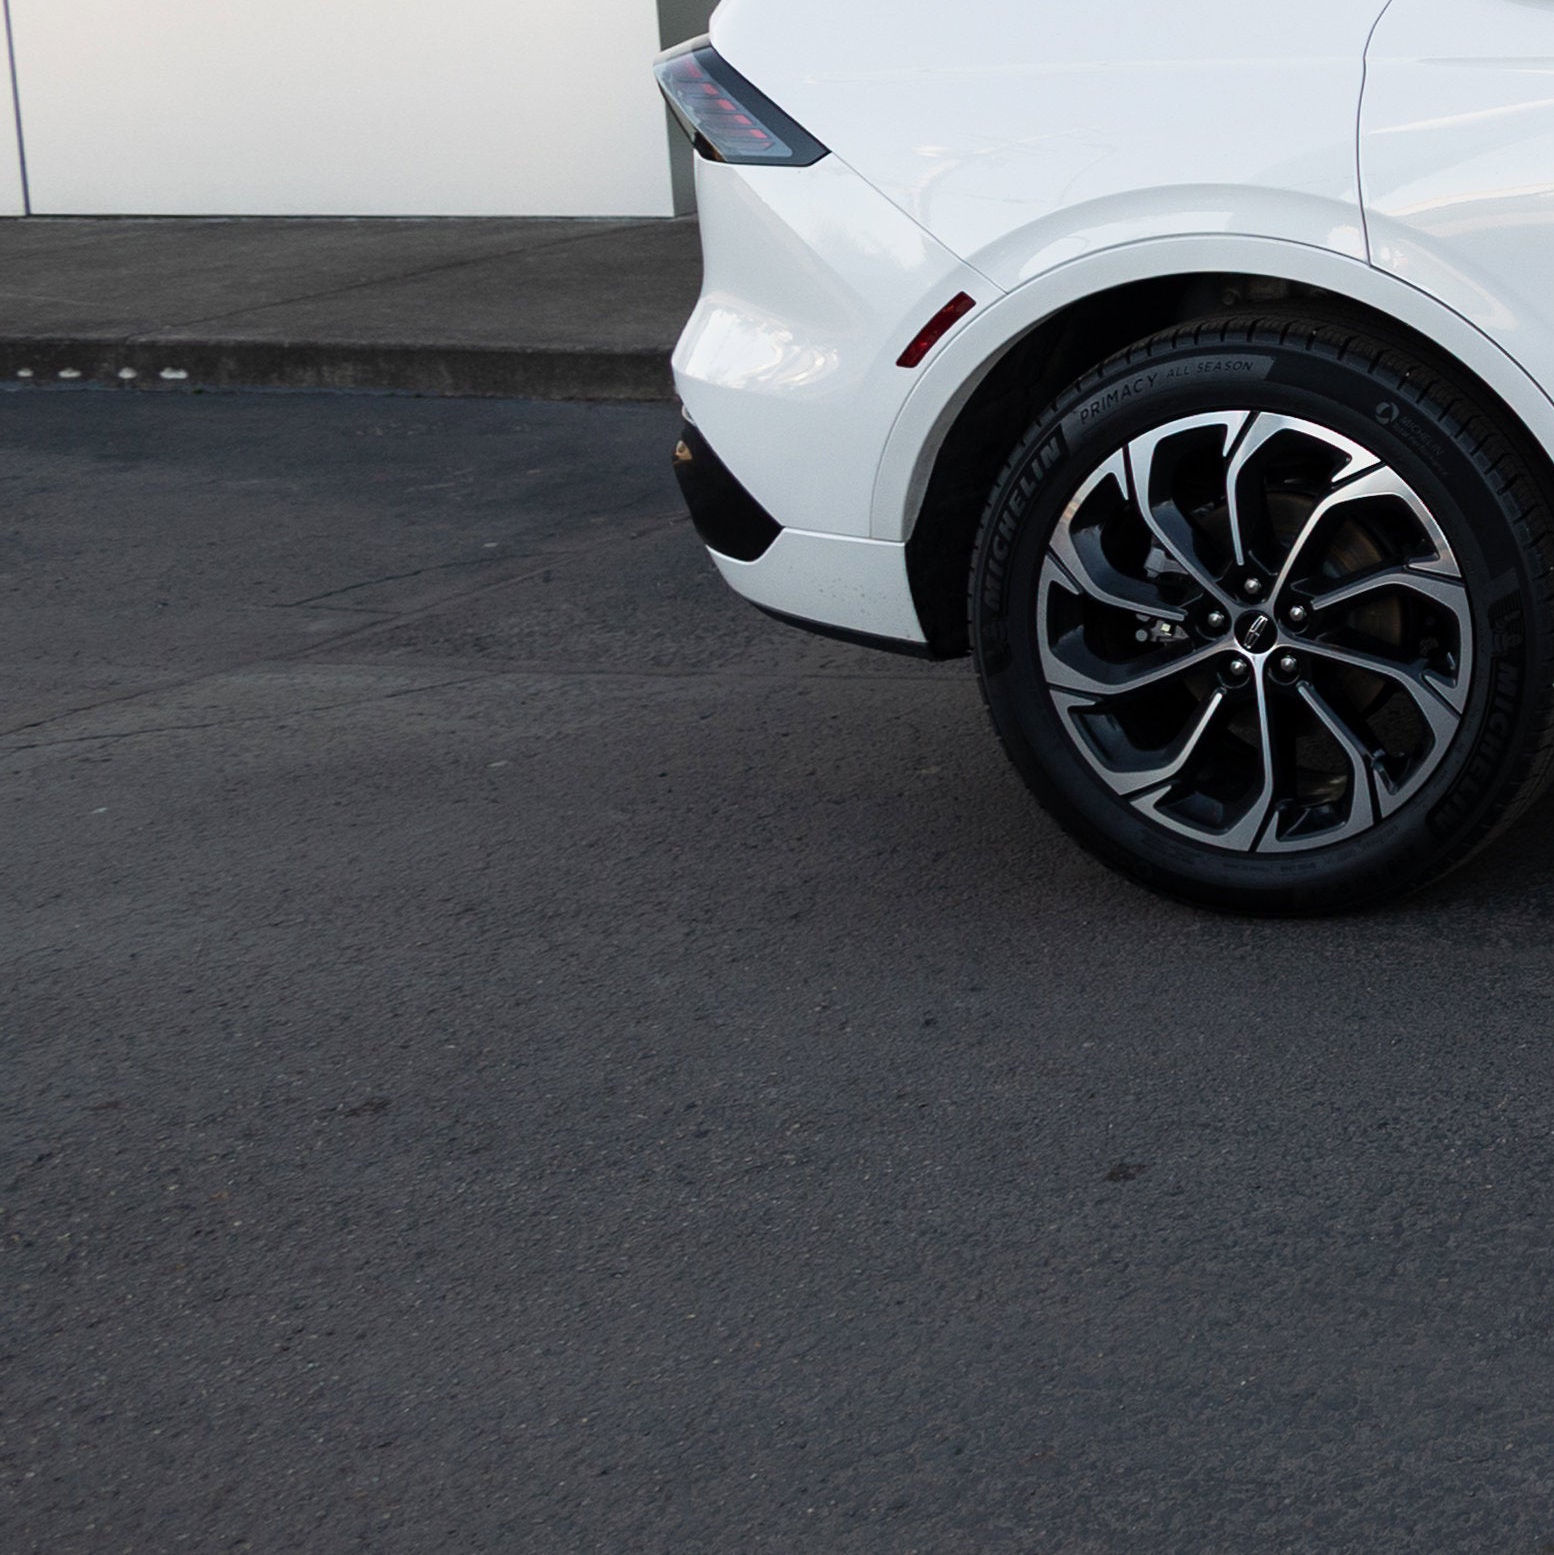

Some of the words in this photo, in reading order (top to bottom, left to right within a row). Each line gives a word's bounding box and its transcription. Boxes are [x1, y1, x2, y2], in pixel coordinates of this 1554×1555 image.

[1079, 372, 1159, 425] PRIMACY
[1166, 365, 1190, 379] ALL
[1195, 360, 1254, 374] SEASON
[984, 437, 1062, 612] MICHELIN
[1432, 662, 1521, 836] MICHELIN
